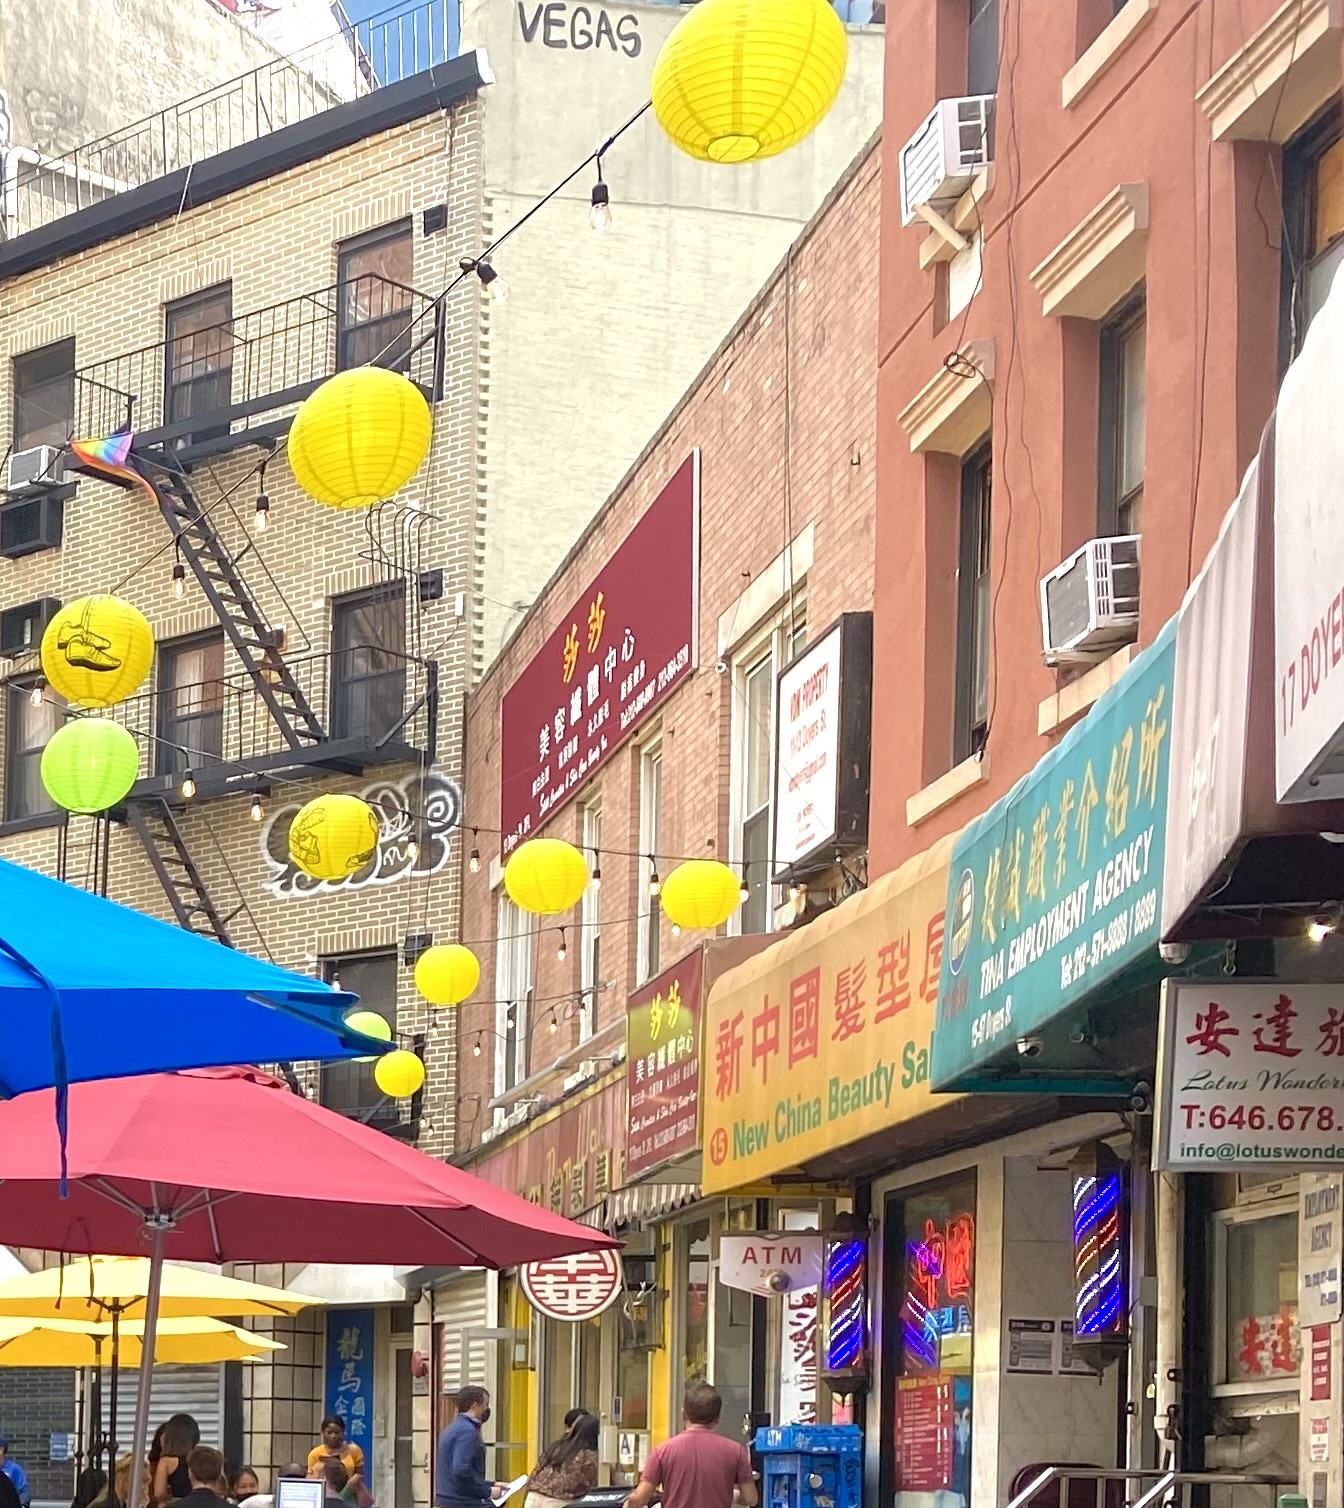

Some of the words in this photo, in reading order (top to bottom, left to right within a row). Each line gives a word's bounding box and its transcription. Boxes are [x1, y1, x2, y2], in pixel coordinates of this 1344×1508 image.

[518, 1, 642, 58] VEGAS
[1282, 661, 1296, 737] 17
[1301, 586, 1344, 713] DOYE
[980, 948, 1005, 999] TINA
[1007, 880, 1090, 980] EMPLOYMENT
[1091, 824, 1155, 916] AGENCY
[1181, 1069, 1248, 1092] Lotus
[1257, 1068, 1344, 1092] Wonder
[733, 1115, 770, 1160] New
[775, 1093, 822, 1143] China
[828, 1057, 896, 1121] Beauty
[712, 1130, 725, 1163] 15
[742, 1246, 802, 1264] ATM
[620, 1433, 631, 1455] A
[767, 1429, 782, 1447] ATM
